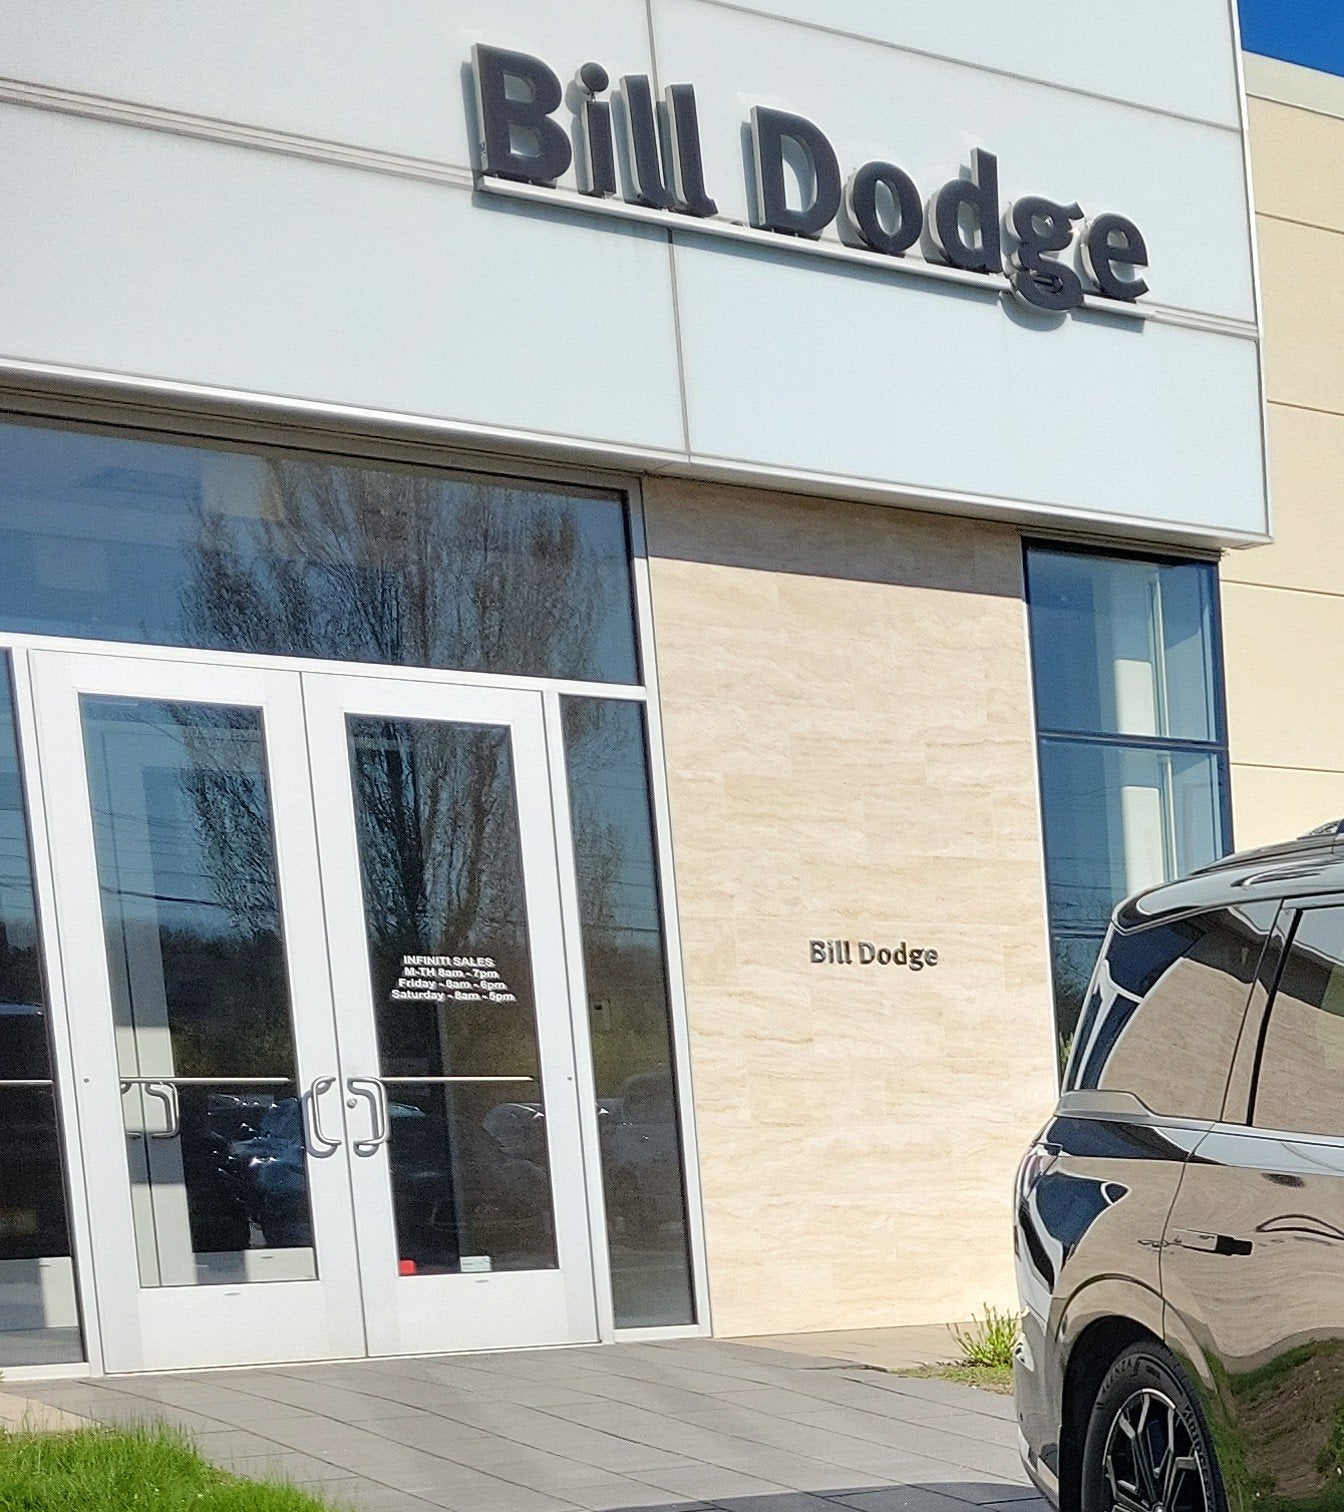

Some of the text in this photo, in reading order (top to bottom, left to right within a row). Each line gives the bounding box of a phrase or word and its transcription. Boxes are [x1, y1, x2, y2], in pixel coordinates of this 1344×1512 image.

[471, 43, 1150, 311] Bill Dodge
[403, 955, 495, 968] INFINITI SALES
[808, 939, 939, 971] Bill Dodge
[404, 967, 437, 977] M-TH
[438, 968, 466, 978] 8am
[472, 968, 500, 979] 7pm
[398, 978, 437, 990] Friday
[392, 989, 445, 1002] Saturday
[454, 990, 483, 1001] 8am
